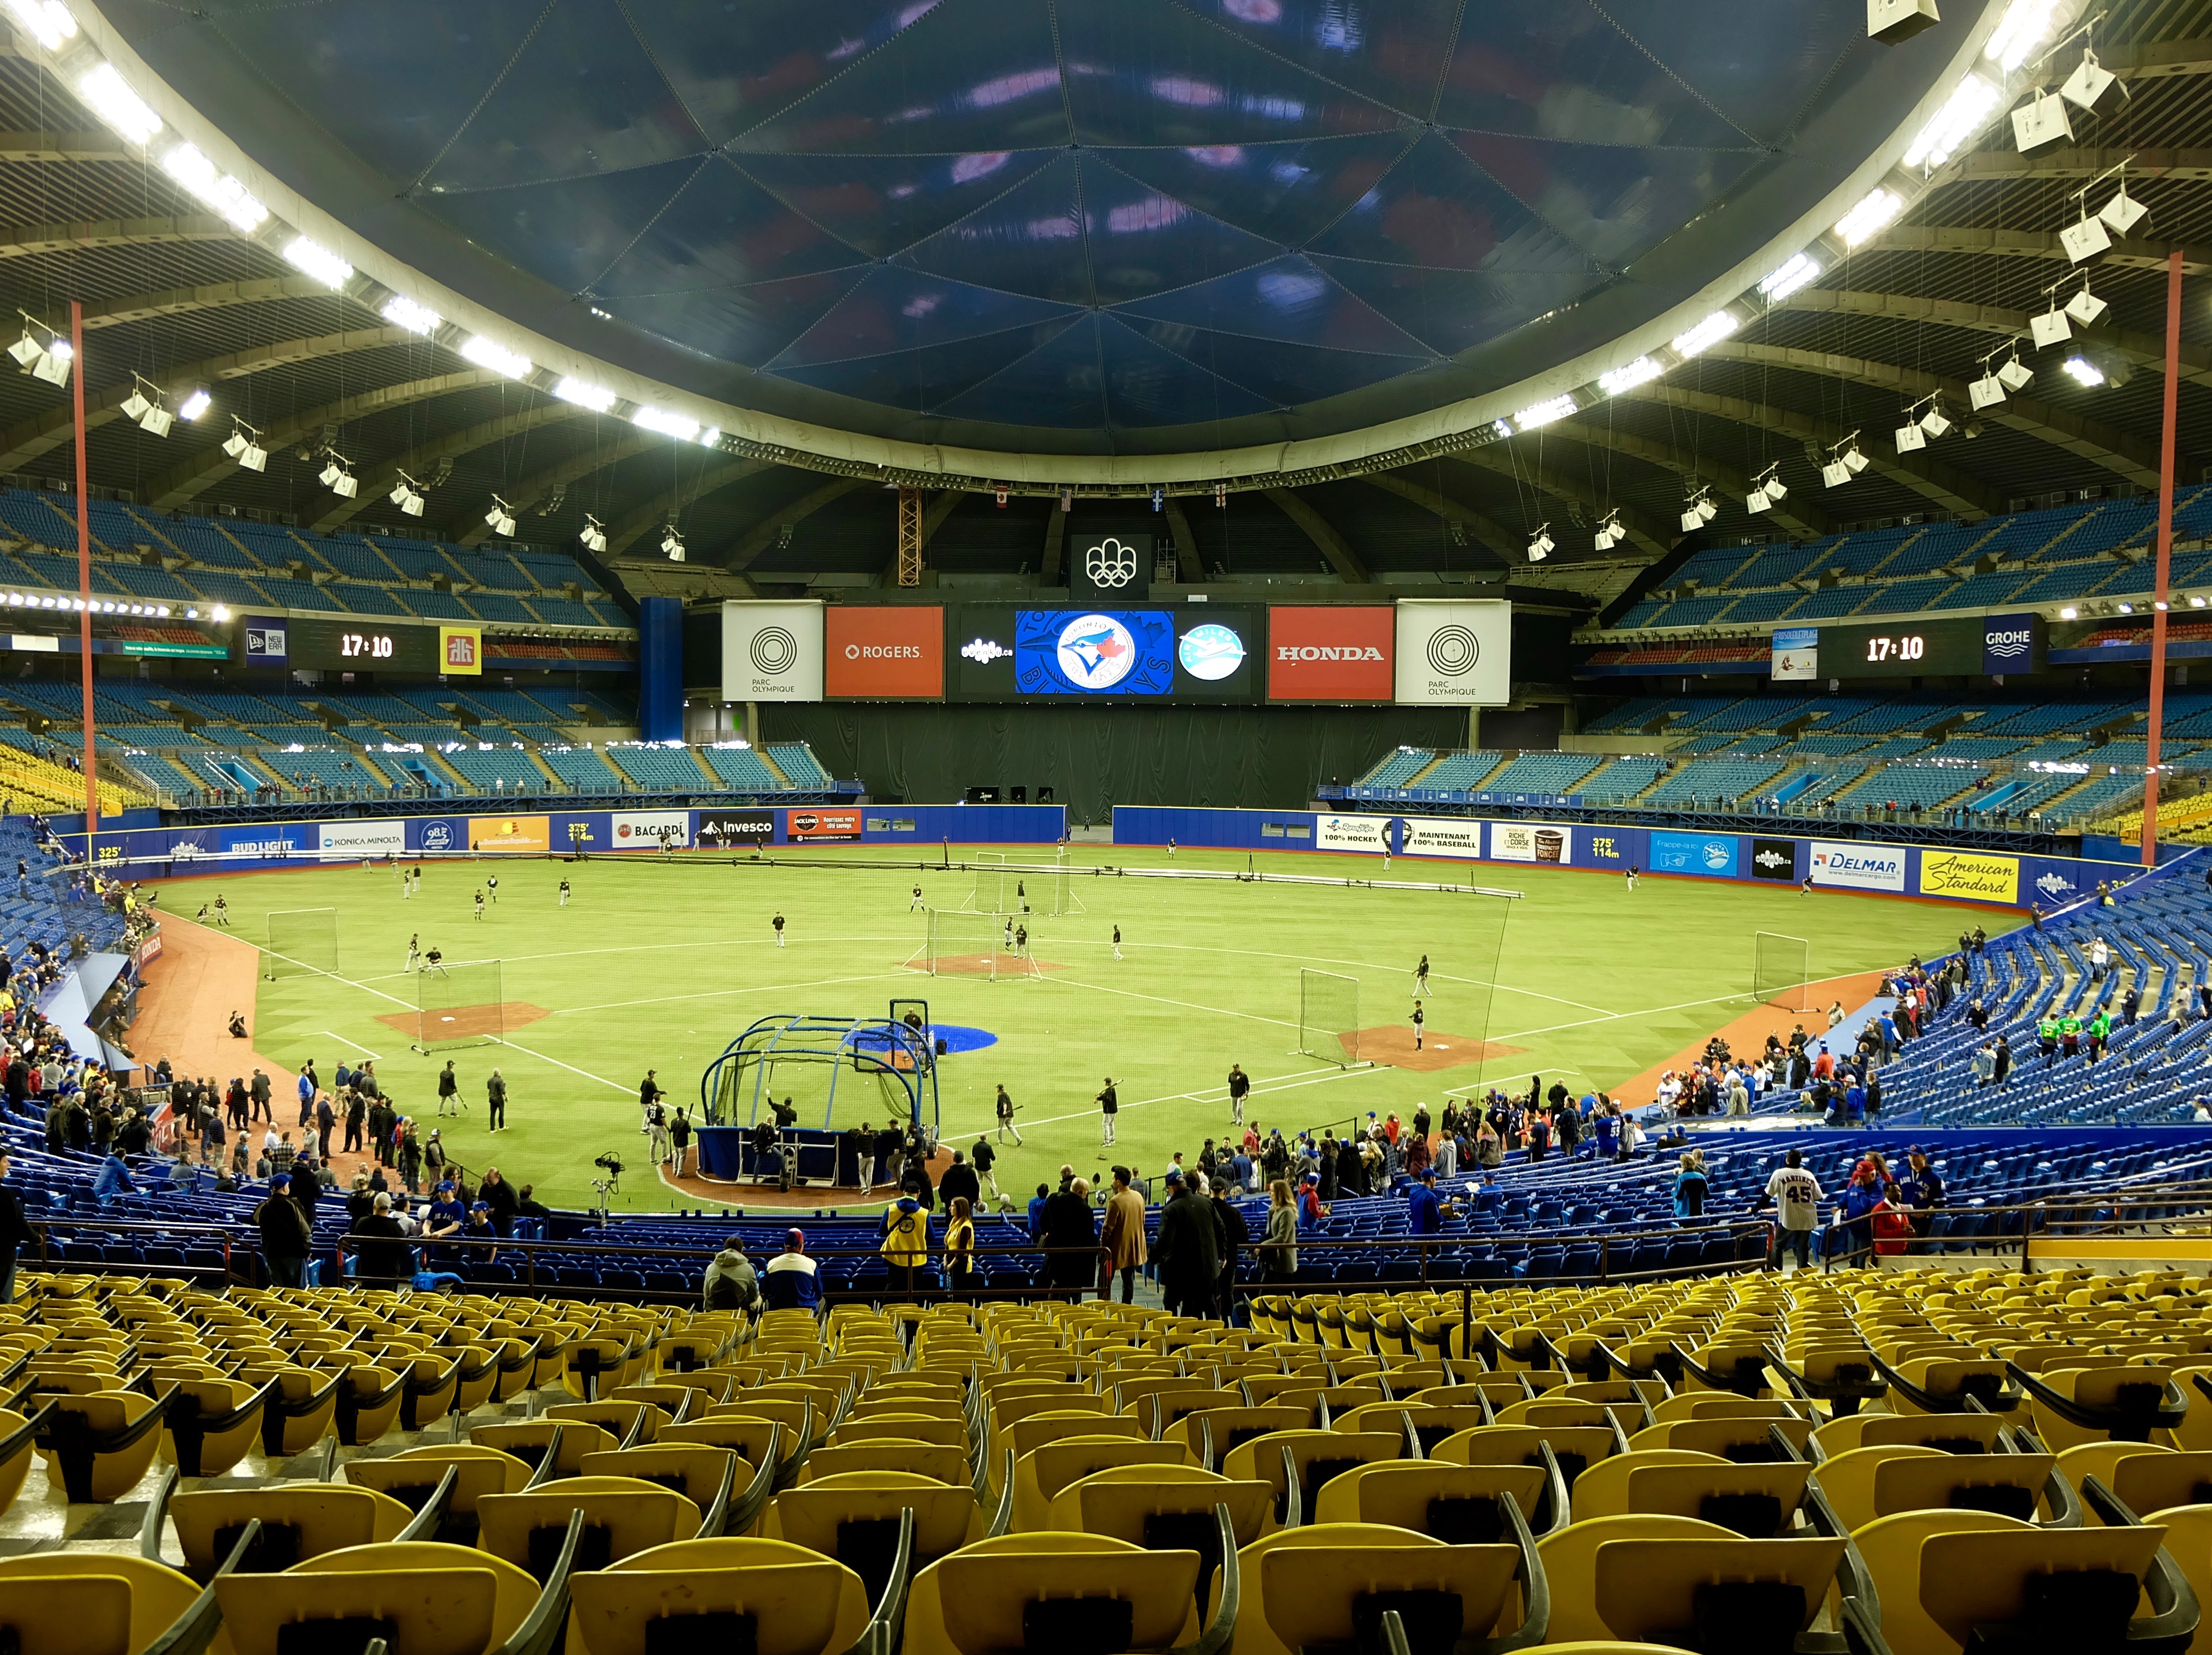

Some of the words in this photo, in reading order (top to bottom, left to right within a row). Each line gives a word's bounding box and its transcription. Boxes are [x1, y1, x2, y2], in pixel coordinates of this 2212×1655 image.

[1195, 628, 1232, 641] MILES
[1986, 630, 2030, 644] GROHE
[269, 642, 282, 651] ERA
[342, 635, 393, 658] 17:10
[863, 646, 920, 658] ROGERS
[1868, 637, 1923, 661] 17:10
[1277, 646, 1384, 661] HONDA
[427, 827, 447, 840] 98.5
[635, 822, 683, 836] BACARDÍ
[724, 821, 772, 833] Invesco
[232, 842, 258, 853] BUD
[258, 840, 294, 851] LIGHT
[1593, 838, 1615, 848] 375'
[1593, 848, 1619, 858] 114m
[1829, 853, 1896, 873] DELMAR
[1928, 855, 2015, 876] American
[1828, 871, 1896, 880] www.delmarcargo.com
[1923, 871, 2007, 893] Standard
[1610, 1126, 1620, 1137] 55
[1786, 1185, 1811, 1203] 45
